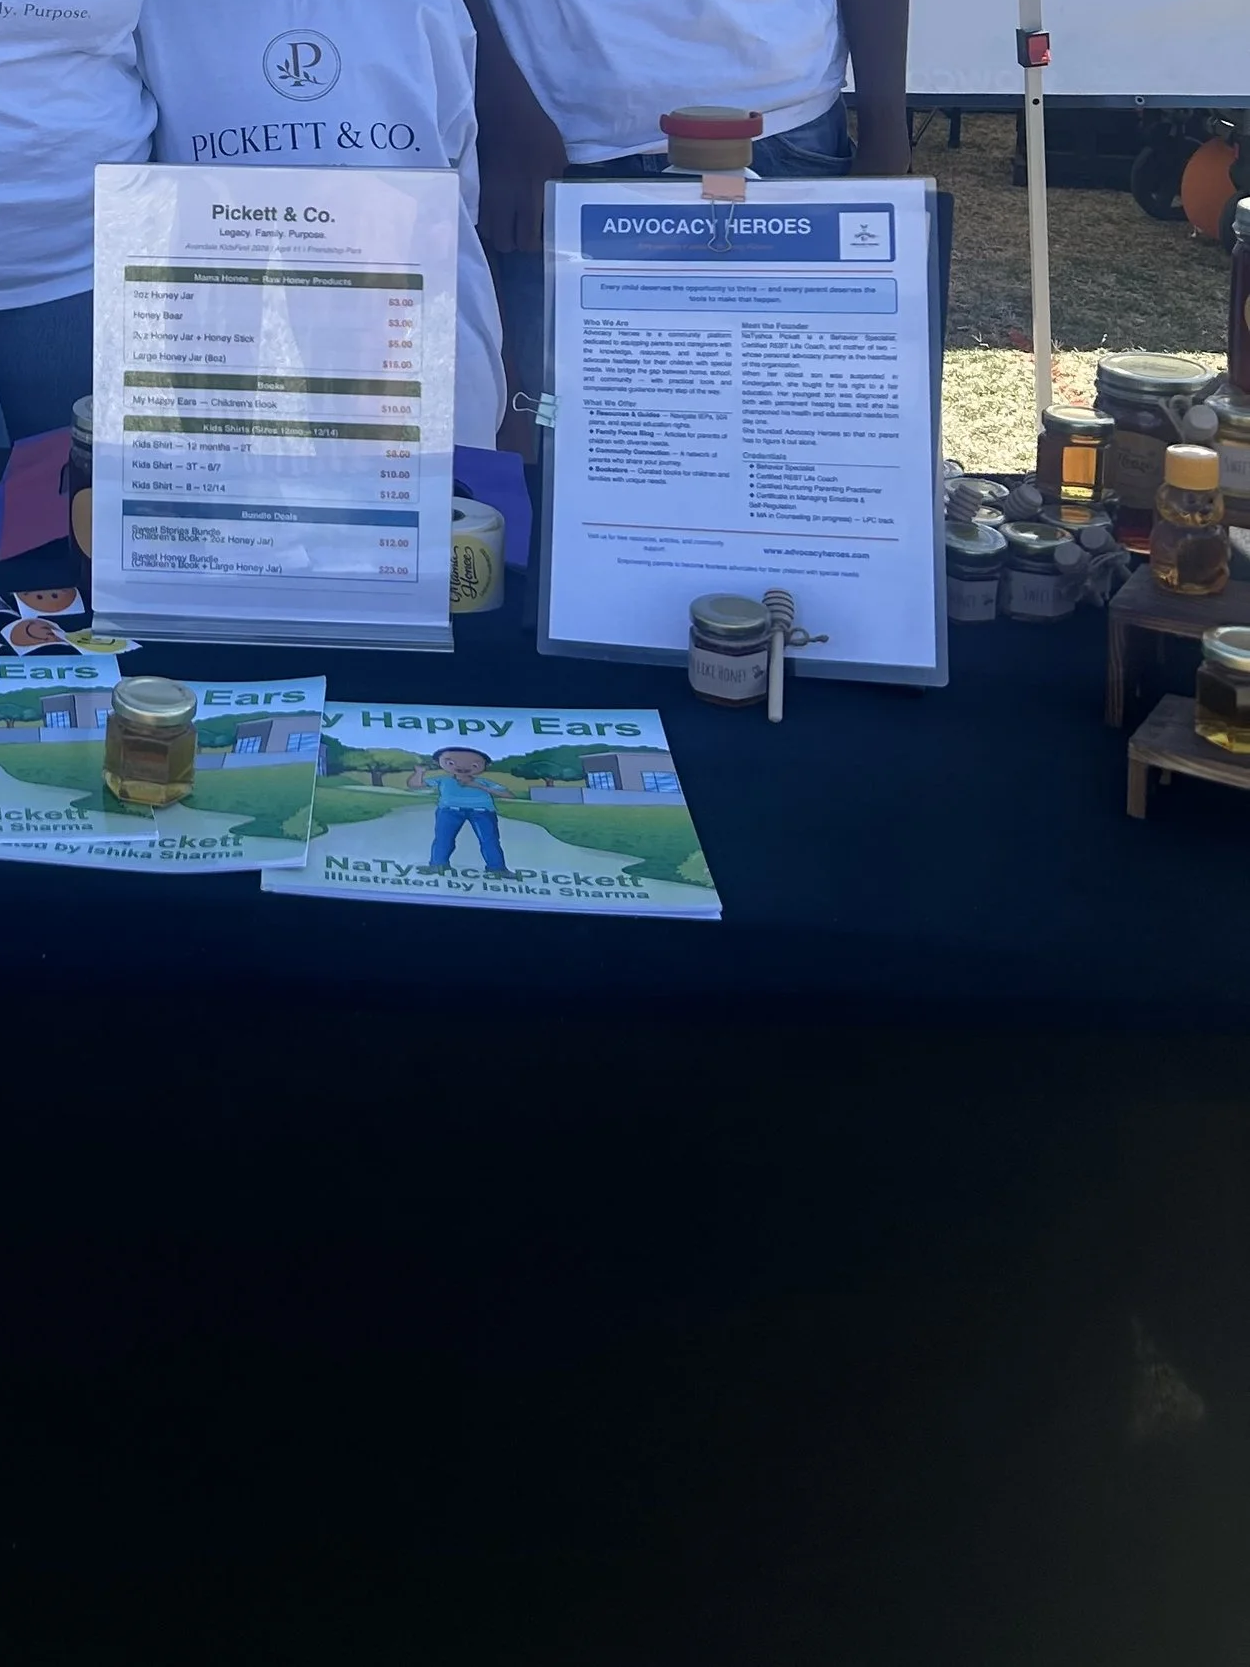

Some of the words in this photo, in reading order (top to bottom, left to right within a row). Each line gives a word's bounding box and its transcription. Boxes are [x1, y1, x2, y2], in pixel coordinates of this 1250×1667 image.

[23, 3, 91, 21] Purpose.
[286, 41, 323, 87] P
[191, 122, 327, 162] PICKETT
[337, 121, 364, 149] &
[370, 122, 421, 152] CO.
[212, 204, 278, 221] Pickett
[284, 207, 297, 222] &
[303, 207, 336, 223] Co.
[603, 218, 718, 234] ADVOCACY
[727, 218, 812, 234] HEROES
[288, 230, 327, 240] Purpose.
[194, 274, 220, 282] Mama
[221, 275, 249, 283] Honee
[283, 277, 310, 285] Honey
[313, 278, 351, 286] Products
[151, 291, 179, 301] Honey
[181, 292, 194, 300] Jar
[388, 298, 413, 307] $3.00
[133, 310, 160, 320] Honey
[163, 311, 183, 320] Bear
[583, 319, 600, 327] Who
[602, 319, 614, 327] We
[616, 319, 629, 327] Are
[151, 332, 178, 342] Honey
[180, 332, 193, 341] Jar
[204, 334, 231, 343] Honey
[234, 334, 255, 343] Stick
[388, 340, 413, 349] $5.00
[159, 352, 187, 363] Honey
[189, 353, 203, 362] Jar
[205, 354, 226, 363] (8oz)
[258, 382, 285, 390] Books
[133, 396, 146, 405] My
[177, 397, 197, 406] Ears
[211, 398, 253, 408] Children's
[255, 399, 277, 408] Book
[133, 440, 151, 449] Kids
[153, 440, 173, 449] Shirt
[187, 442, 197, 450] 12
[199, 443, 231, 451] months
[742, 451, 787, 460] Credentials
[132, 460, 151, 469] Kids
[153, 461, 173, 470] Shirt
[186, 462, 198, 470] 3T
[380, 470, 410, 479] $10.00
[132, 481, 151, 490] Kids
[153, 481, 173, 491] Shirt
[203, 483, 226, 492] 12/14
[380, 490, 410, 499] $12.00
[242, 510, 272, 520] Bundle
[274, 511, 298, 521] Deals
[379, 538, 409, 547] $12.00
[763, 547, 870, 559] www.advocacyheroes.com
[378, 566, 409, 575] $23.00
[203, 686, 306, 706] Ears
[361, 711, 515, 737] Happy
[530, 716, 642, 737] Ears
[10, 821, 93, 832] Sharma
[148, 834, 244, 849] ickett
[55, 842, 81, 854] by
[87, 844, 152, 860] Ishika
[160, 849, 244, 860] Sharma
[324, 871, 440, 888] Illustrated
[448, 879, 475, 892] by
[482, 881, 552, 896] Ishika
[559, 887, 650, 900] Sharma
[516, 868, 644, 888] Pickett
